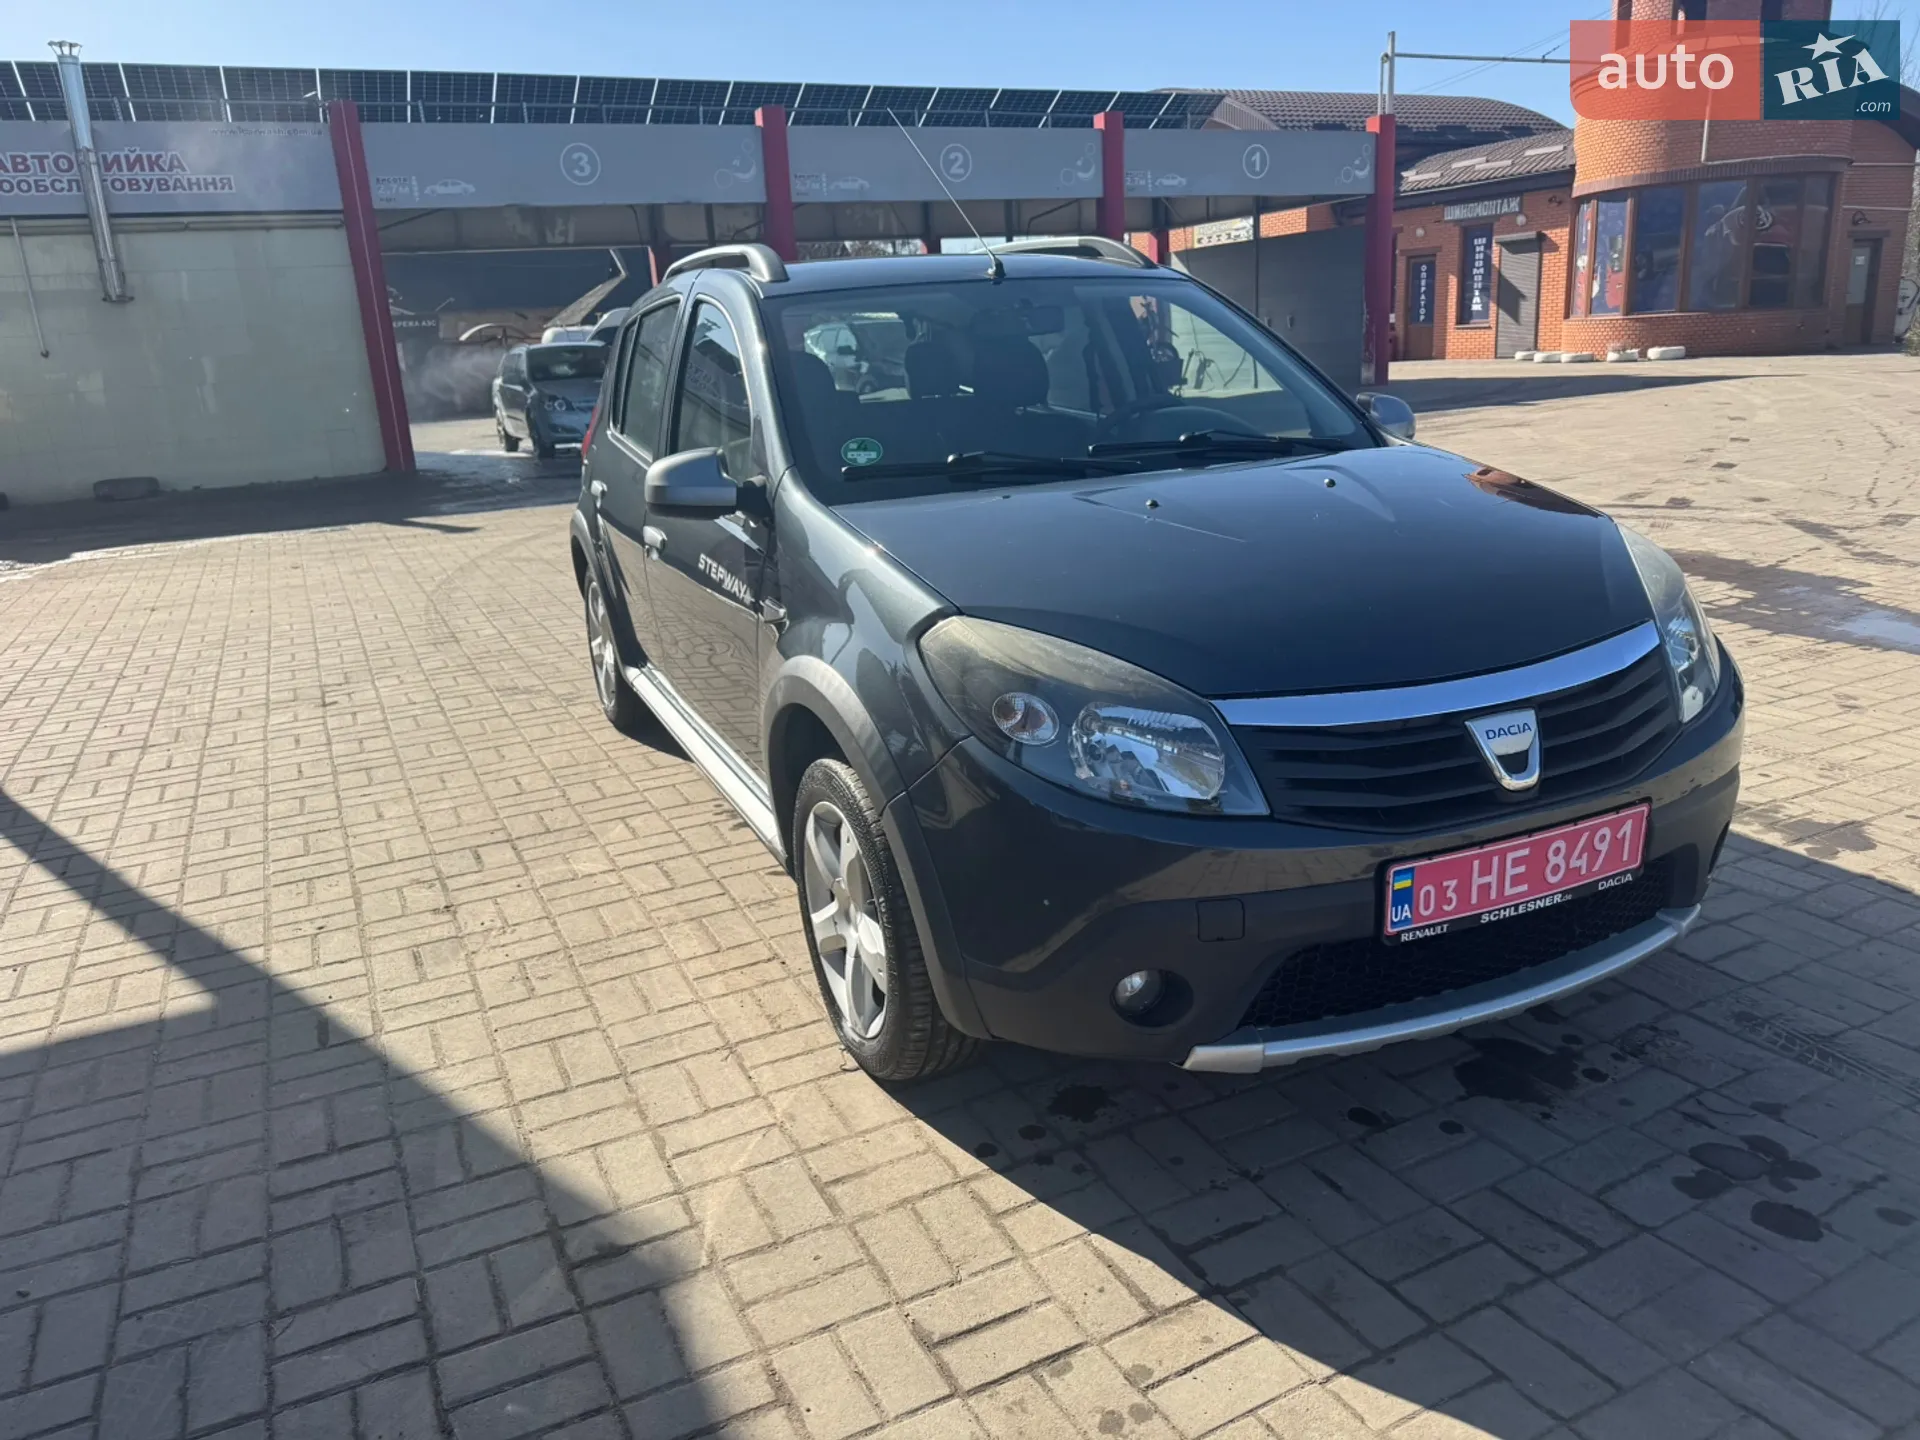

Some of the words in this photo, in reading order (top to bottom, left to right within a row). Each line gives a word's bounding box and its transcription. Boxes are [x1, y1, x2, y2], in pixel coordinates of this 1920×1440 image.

[0, 147, 188, 174] АВТОИЙКА
[572, 152, 591, 176] 3
[949, 152, 965, 174] 2
[1251, 152, 1260, 172] 1
[1443, 197, 1521, 221] ШИНОМОНТАЖ
[1471, 237, 1487, 311] ШИНОМОНТАЖ
[1419, 264, 1427, 322] ОПЕРАТОР
[698, 552, 747, 600] STEPWAY
[1485, 722, 1532, 740] DACIA
[1419, 879, 1458, 917] 03
[1471, 847, 1530, 905] HE
[1545, 819, 1633, 884] 8491
[1598, 873, 1633, 891] DACIA
[1392, 903, 1412, 922] UA
[1401, 923, 1449, 942] RENAULT
